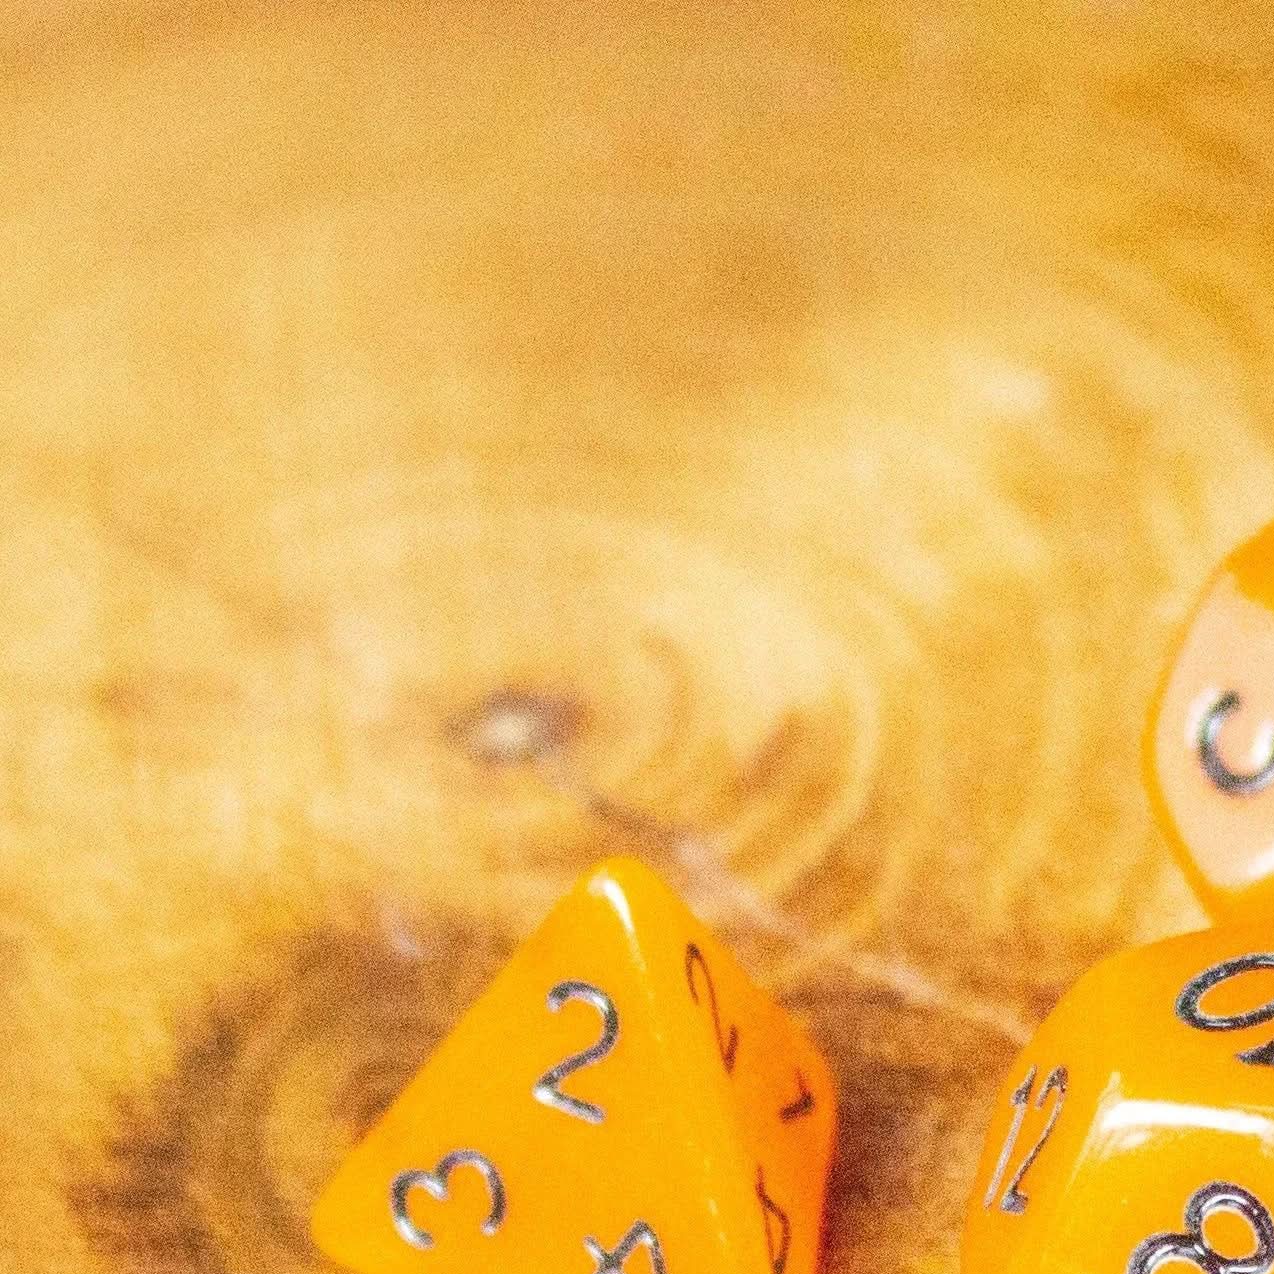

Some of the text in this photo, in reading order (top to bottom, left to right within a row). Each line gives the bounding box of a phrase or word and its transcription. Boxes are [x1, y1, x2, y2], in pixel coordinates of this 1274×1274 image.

[532, 980, 619, 1124] 2
[388, 1149, 506, 1250] 3
[982, 1064, 1069, 1214] 12
